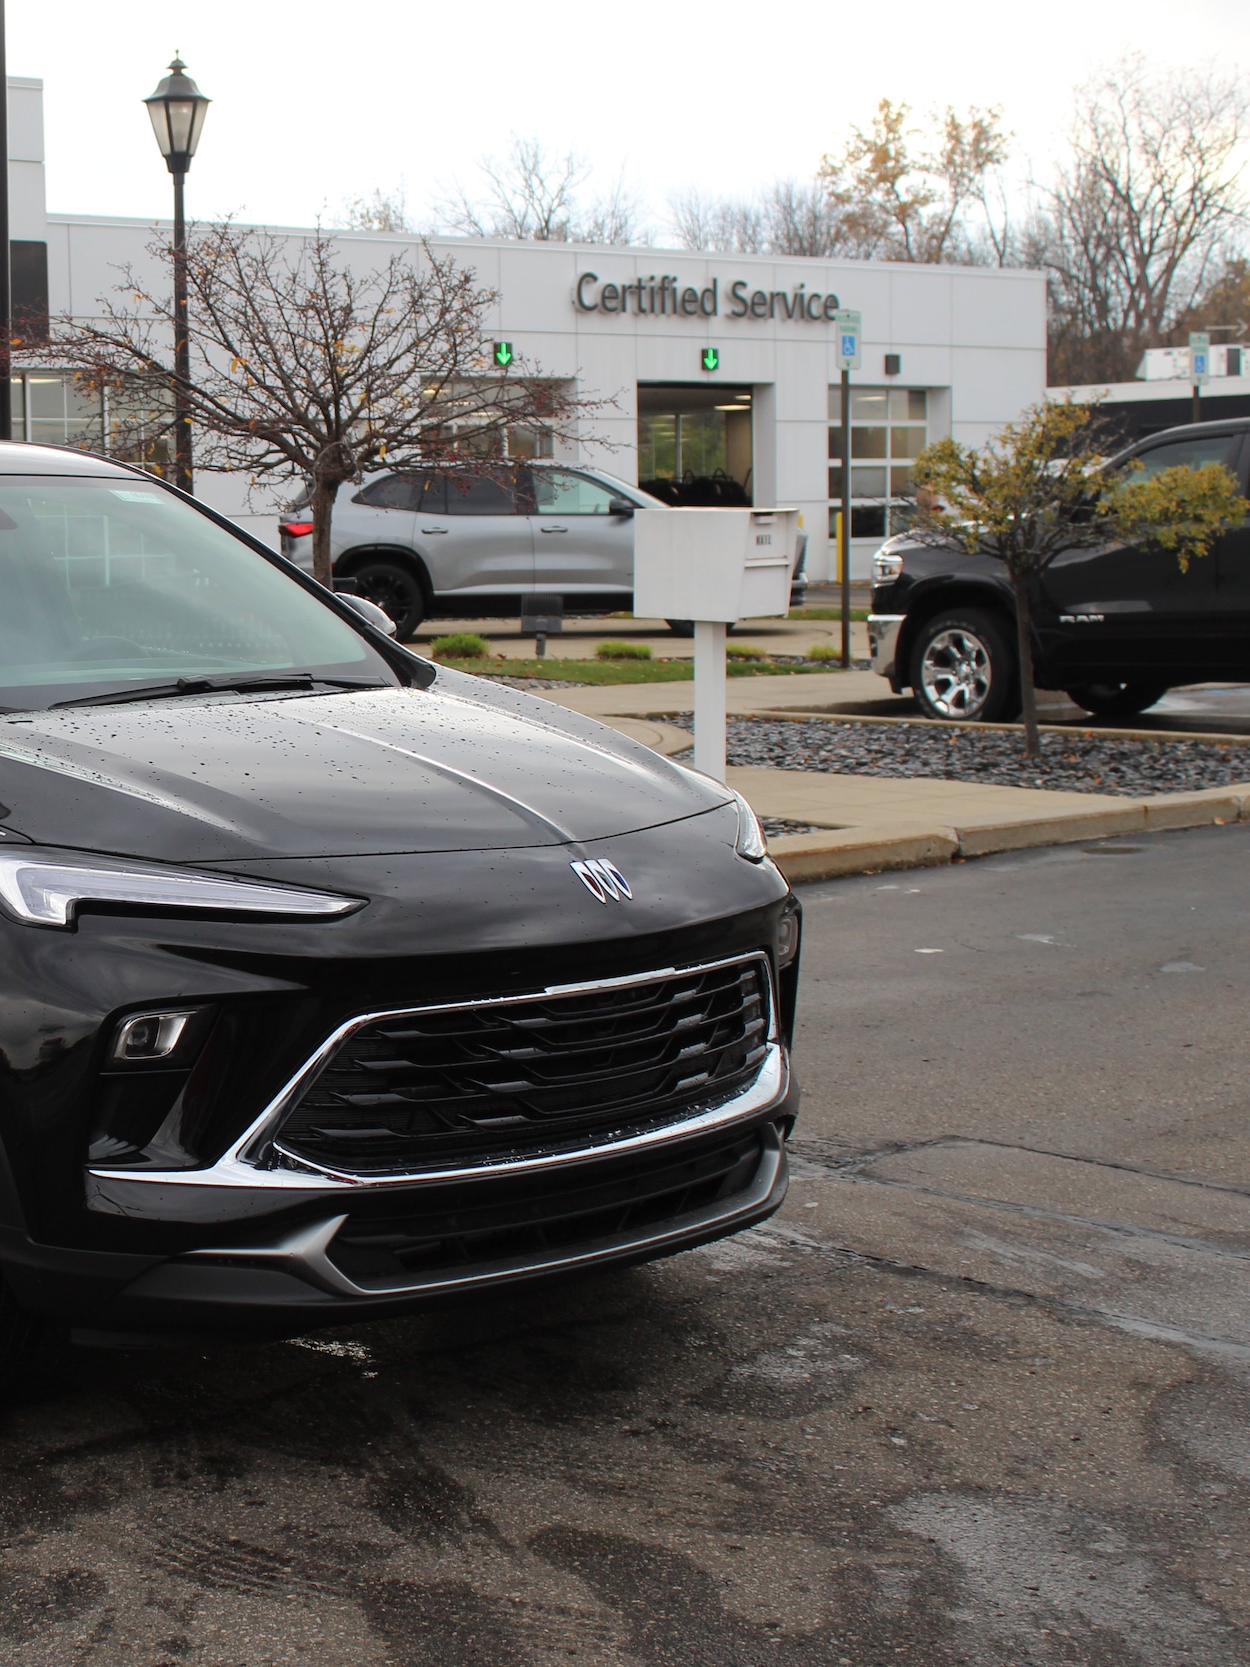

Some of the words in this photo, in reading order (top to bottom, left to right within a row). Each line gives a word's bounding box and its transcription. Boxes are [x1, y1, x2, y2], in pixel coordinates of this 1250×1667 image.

[575, 271, 718, 317] Certified
[729, 280, 840, 321] Service
[1059, 614, 1105, 623] RAM
